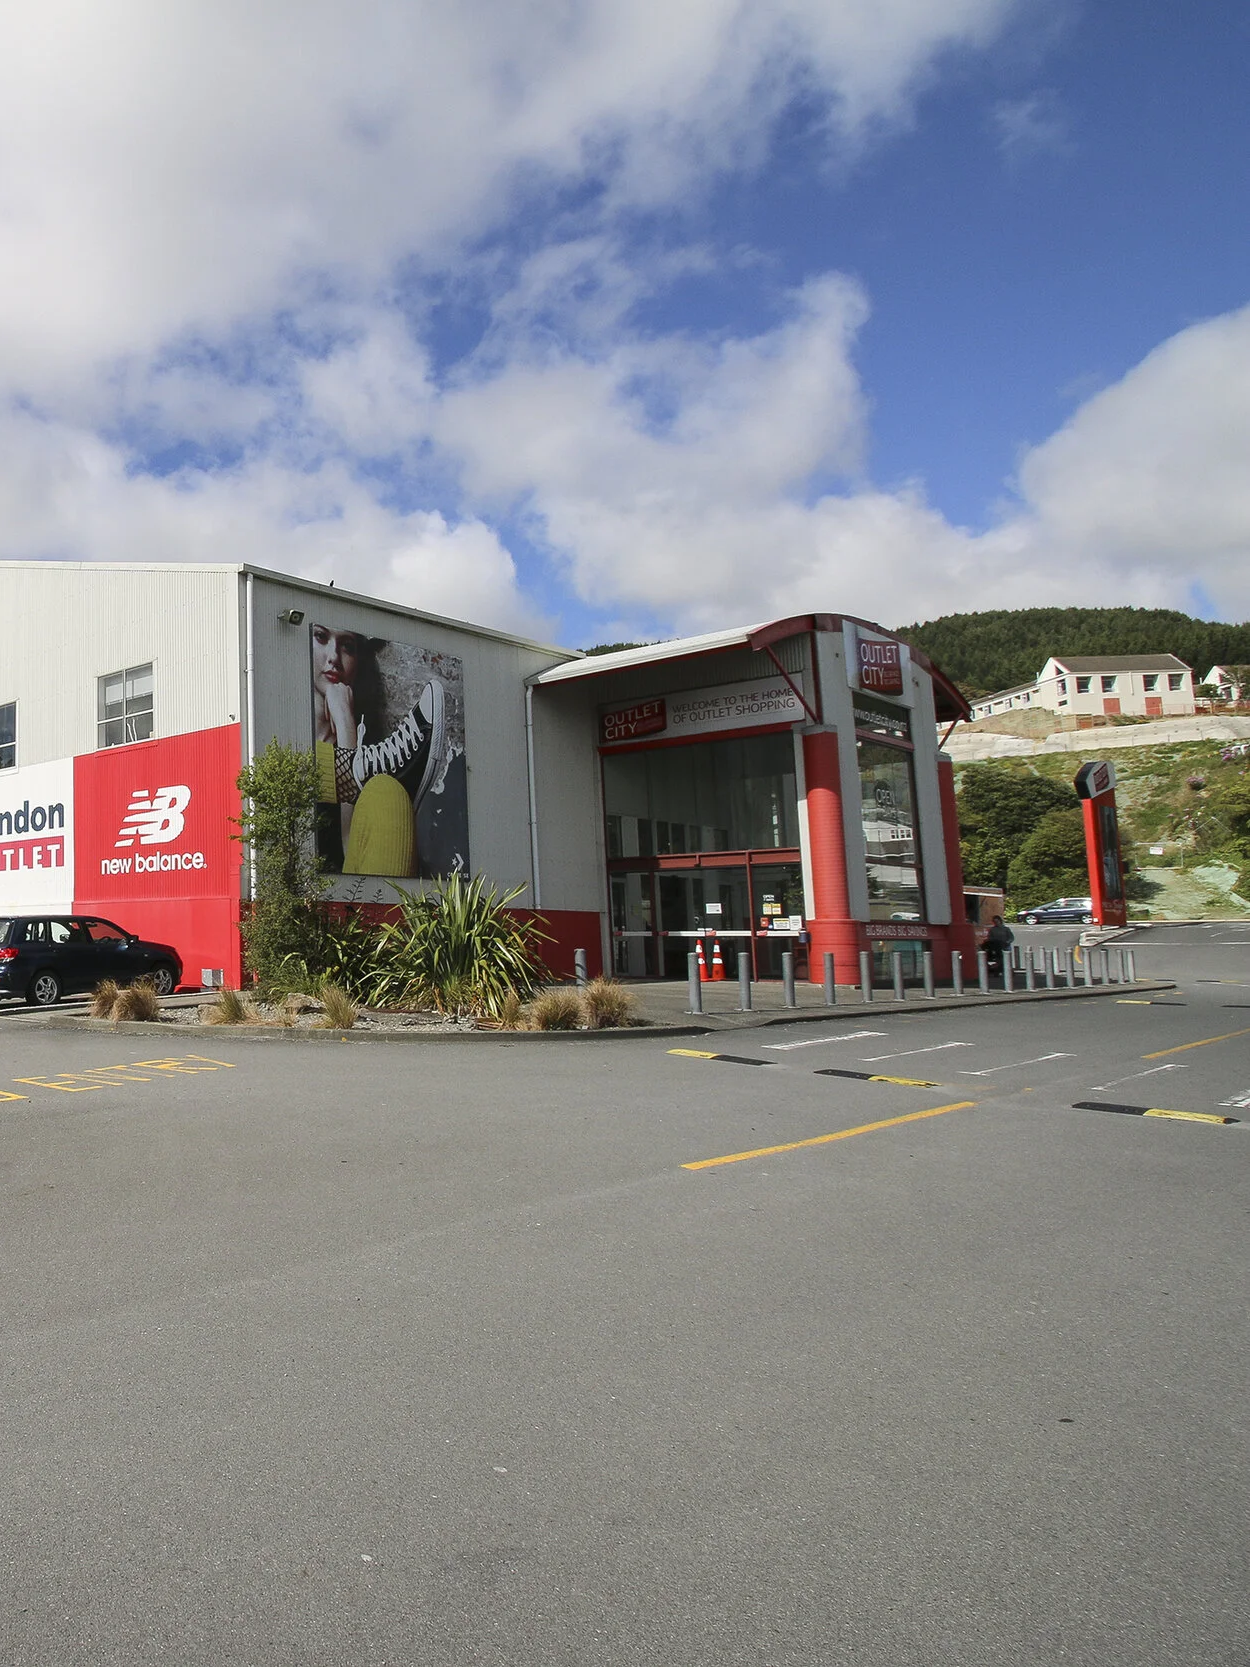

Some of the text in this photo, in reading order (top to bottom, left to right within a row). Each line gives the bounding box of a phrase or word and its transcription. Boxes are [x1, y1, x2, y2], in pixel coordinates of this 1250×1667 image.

[860, 643, 897, 664] OUTLET
[862, 665, 884, 686] CITY
[672, 687, 794, 714] WELCOME TO THE HOME
[672, 697, 795, 724] OF OUTLET SHOPPING
[604, 701, 661, 728] OUTLET
[605, 721, 638, 740] CITY
[101, 851, 204, 876] new balance
[12, 1054, 237, 1092] ENTRY
